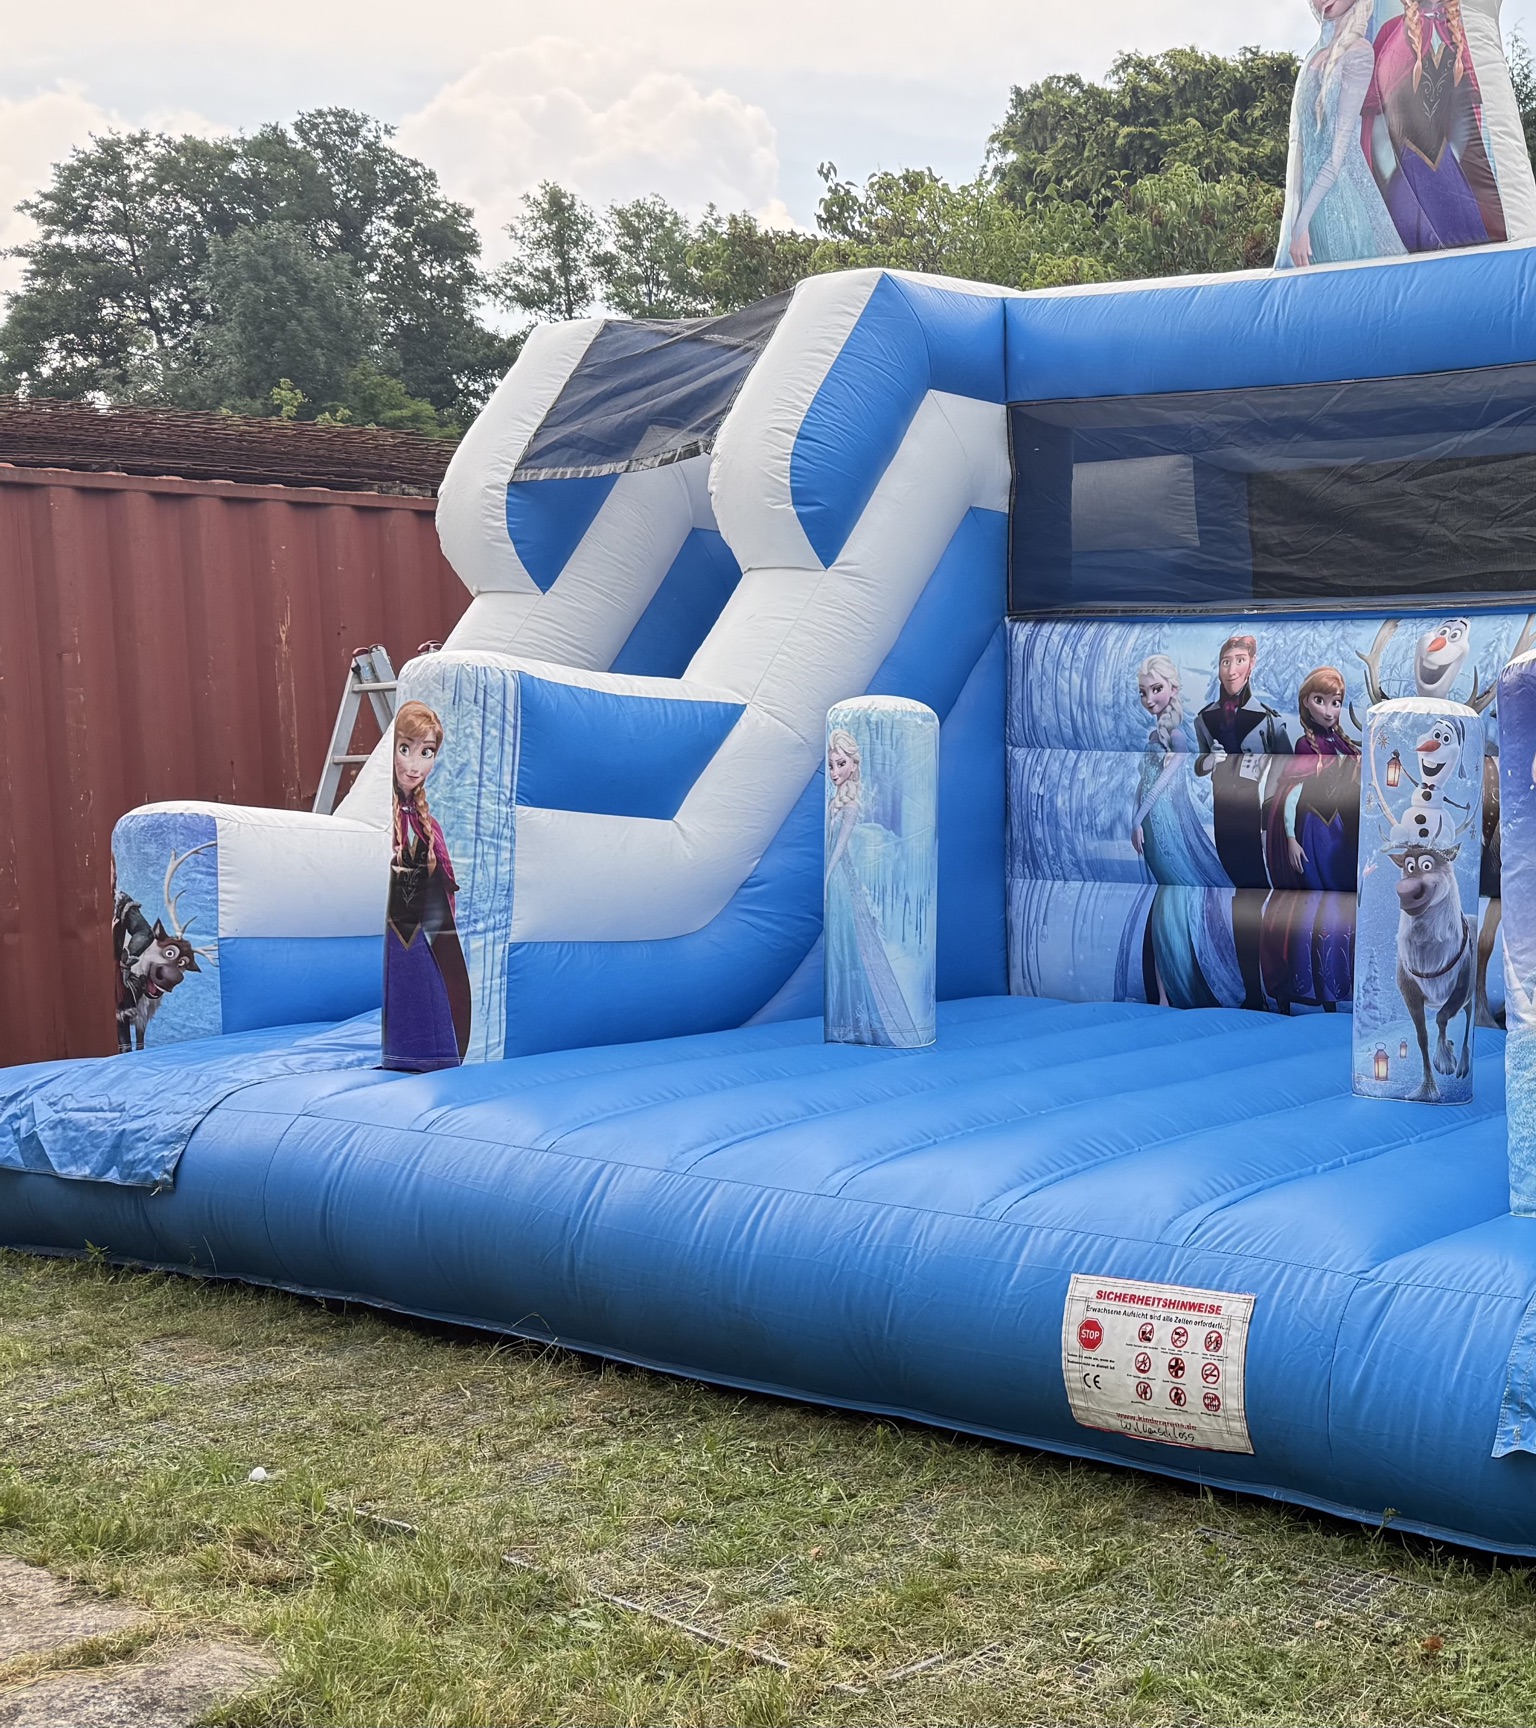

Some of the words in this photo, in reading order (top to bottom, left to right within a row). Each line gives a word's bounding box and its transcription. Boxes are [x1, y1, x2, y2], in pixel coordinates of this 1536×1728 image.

[1096, 1289, 1222, 1315] SICHERHEITSHINWEISE
[1086, 1305, 1121, 1316] Erwachsene
[1122, 1309, 1148, 1320] Aufsicht
[1162, 1315, 1173, 1323] alle
[1174, 1316, 1193, 1326] Zeiten
[1194, 1319, 1229, 1331] erforderlic
[1081, 1329, 1100, 1340] STOP
[1083, 1372, 1102, 1390] CE
